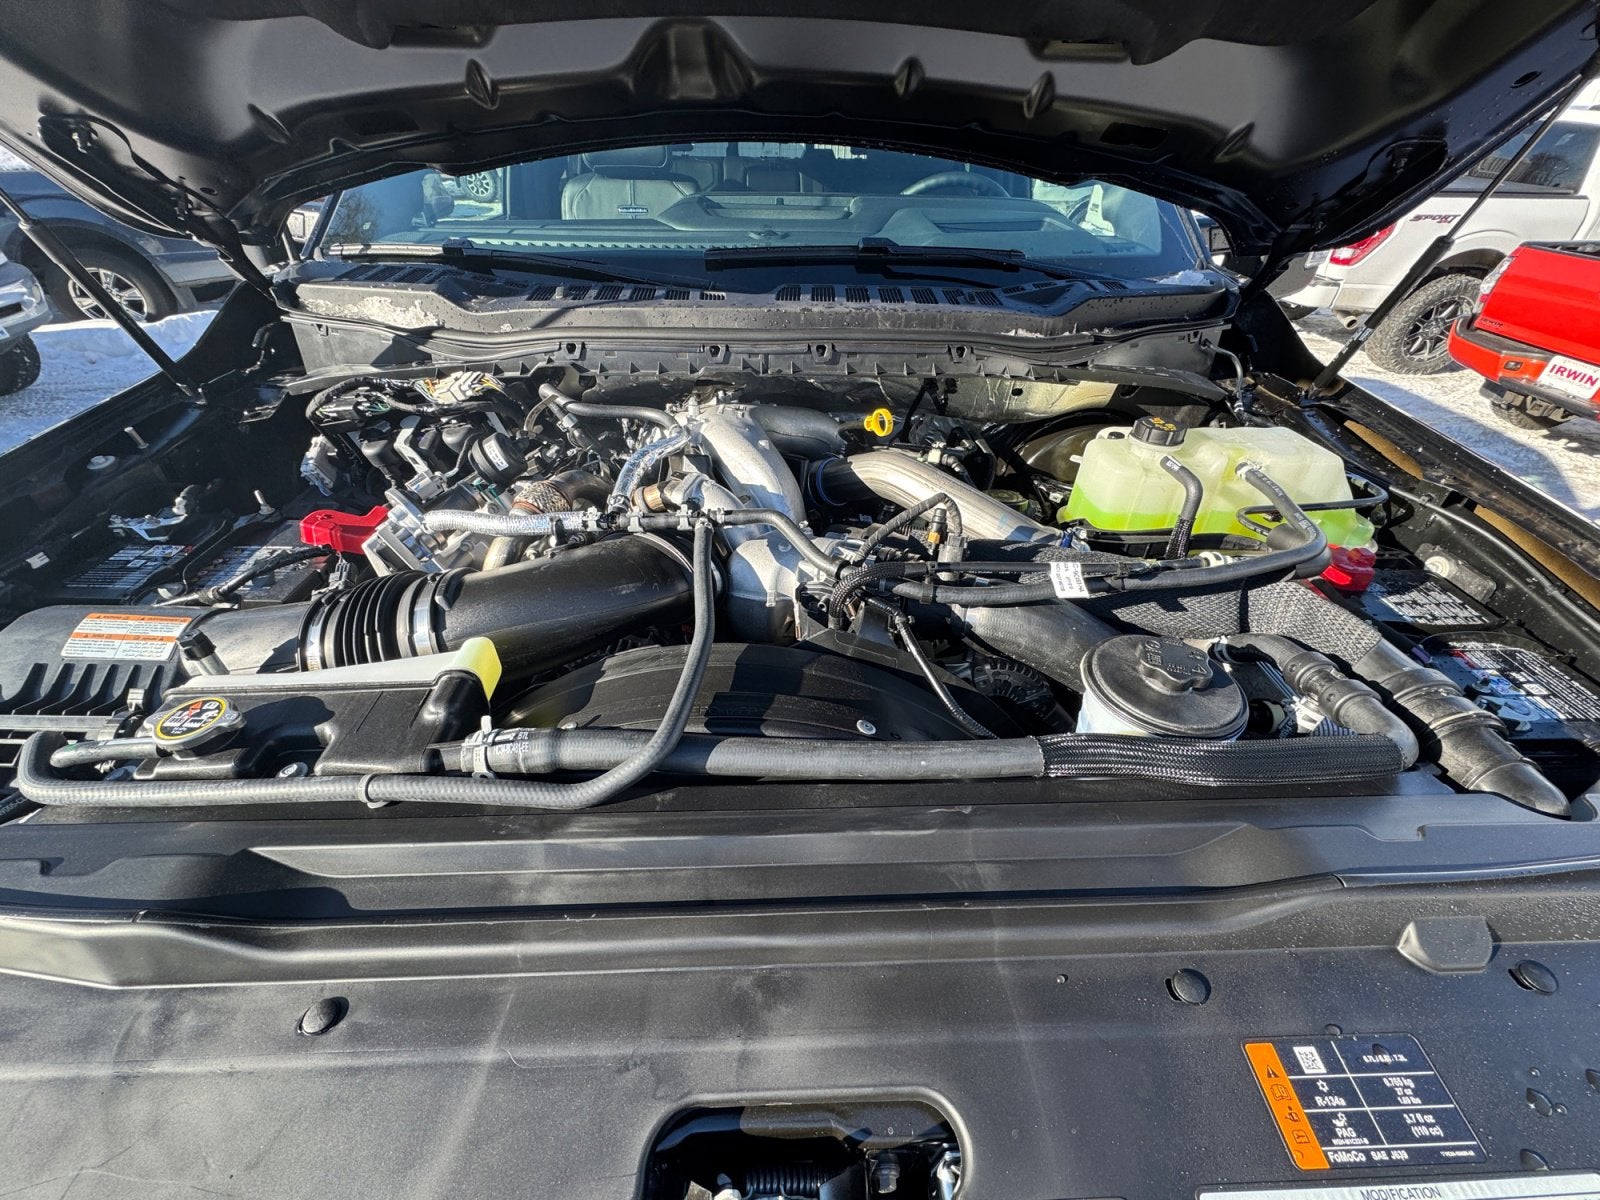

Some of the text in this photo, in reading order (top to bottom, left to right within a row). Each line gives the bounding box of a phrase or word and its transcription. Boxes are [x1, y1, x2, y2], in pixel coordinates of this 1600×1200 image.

[1409, 214, 1461, 223] SPORT
[1549, 364, 1599, 387] IRWIN
[1400, 1076, 1415, 1088] kg
[1315, 1096, 1347, 1107] R-134a
[1403, 1113, 1416, 1124] 3.7
[1423, 1114, 1436, 1123] oz
[1335, 1127, 1357, 1138] PAG
[1410, 1124, 1444, 1139] (110 cc)
[1327, 1151, 1367, 1163] FoMoCo
[1370, 1151, 1390, 1161] SAE
[1359, 1186, 1442, 1200] MODIFICATION
